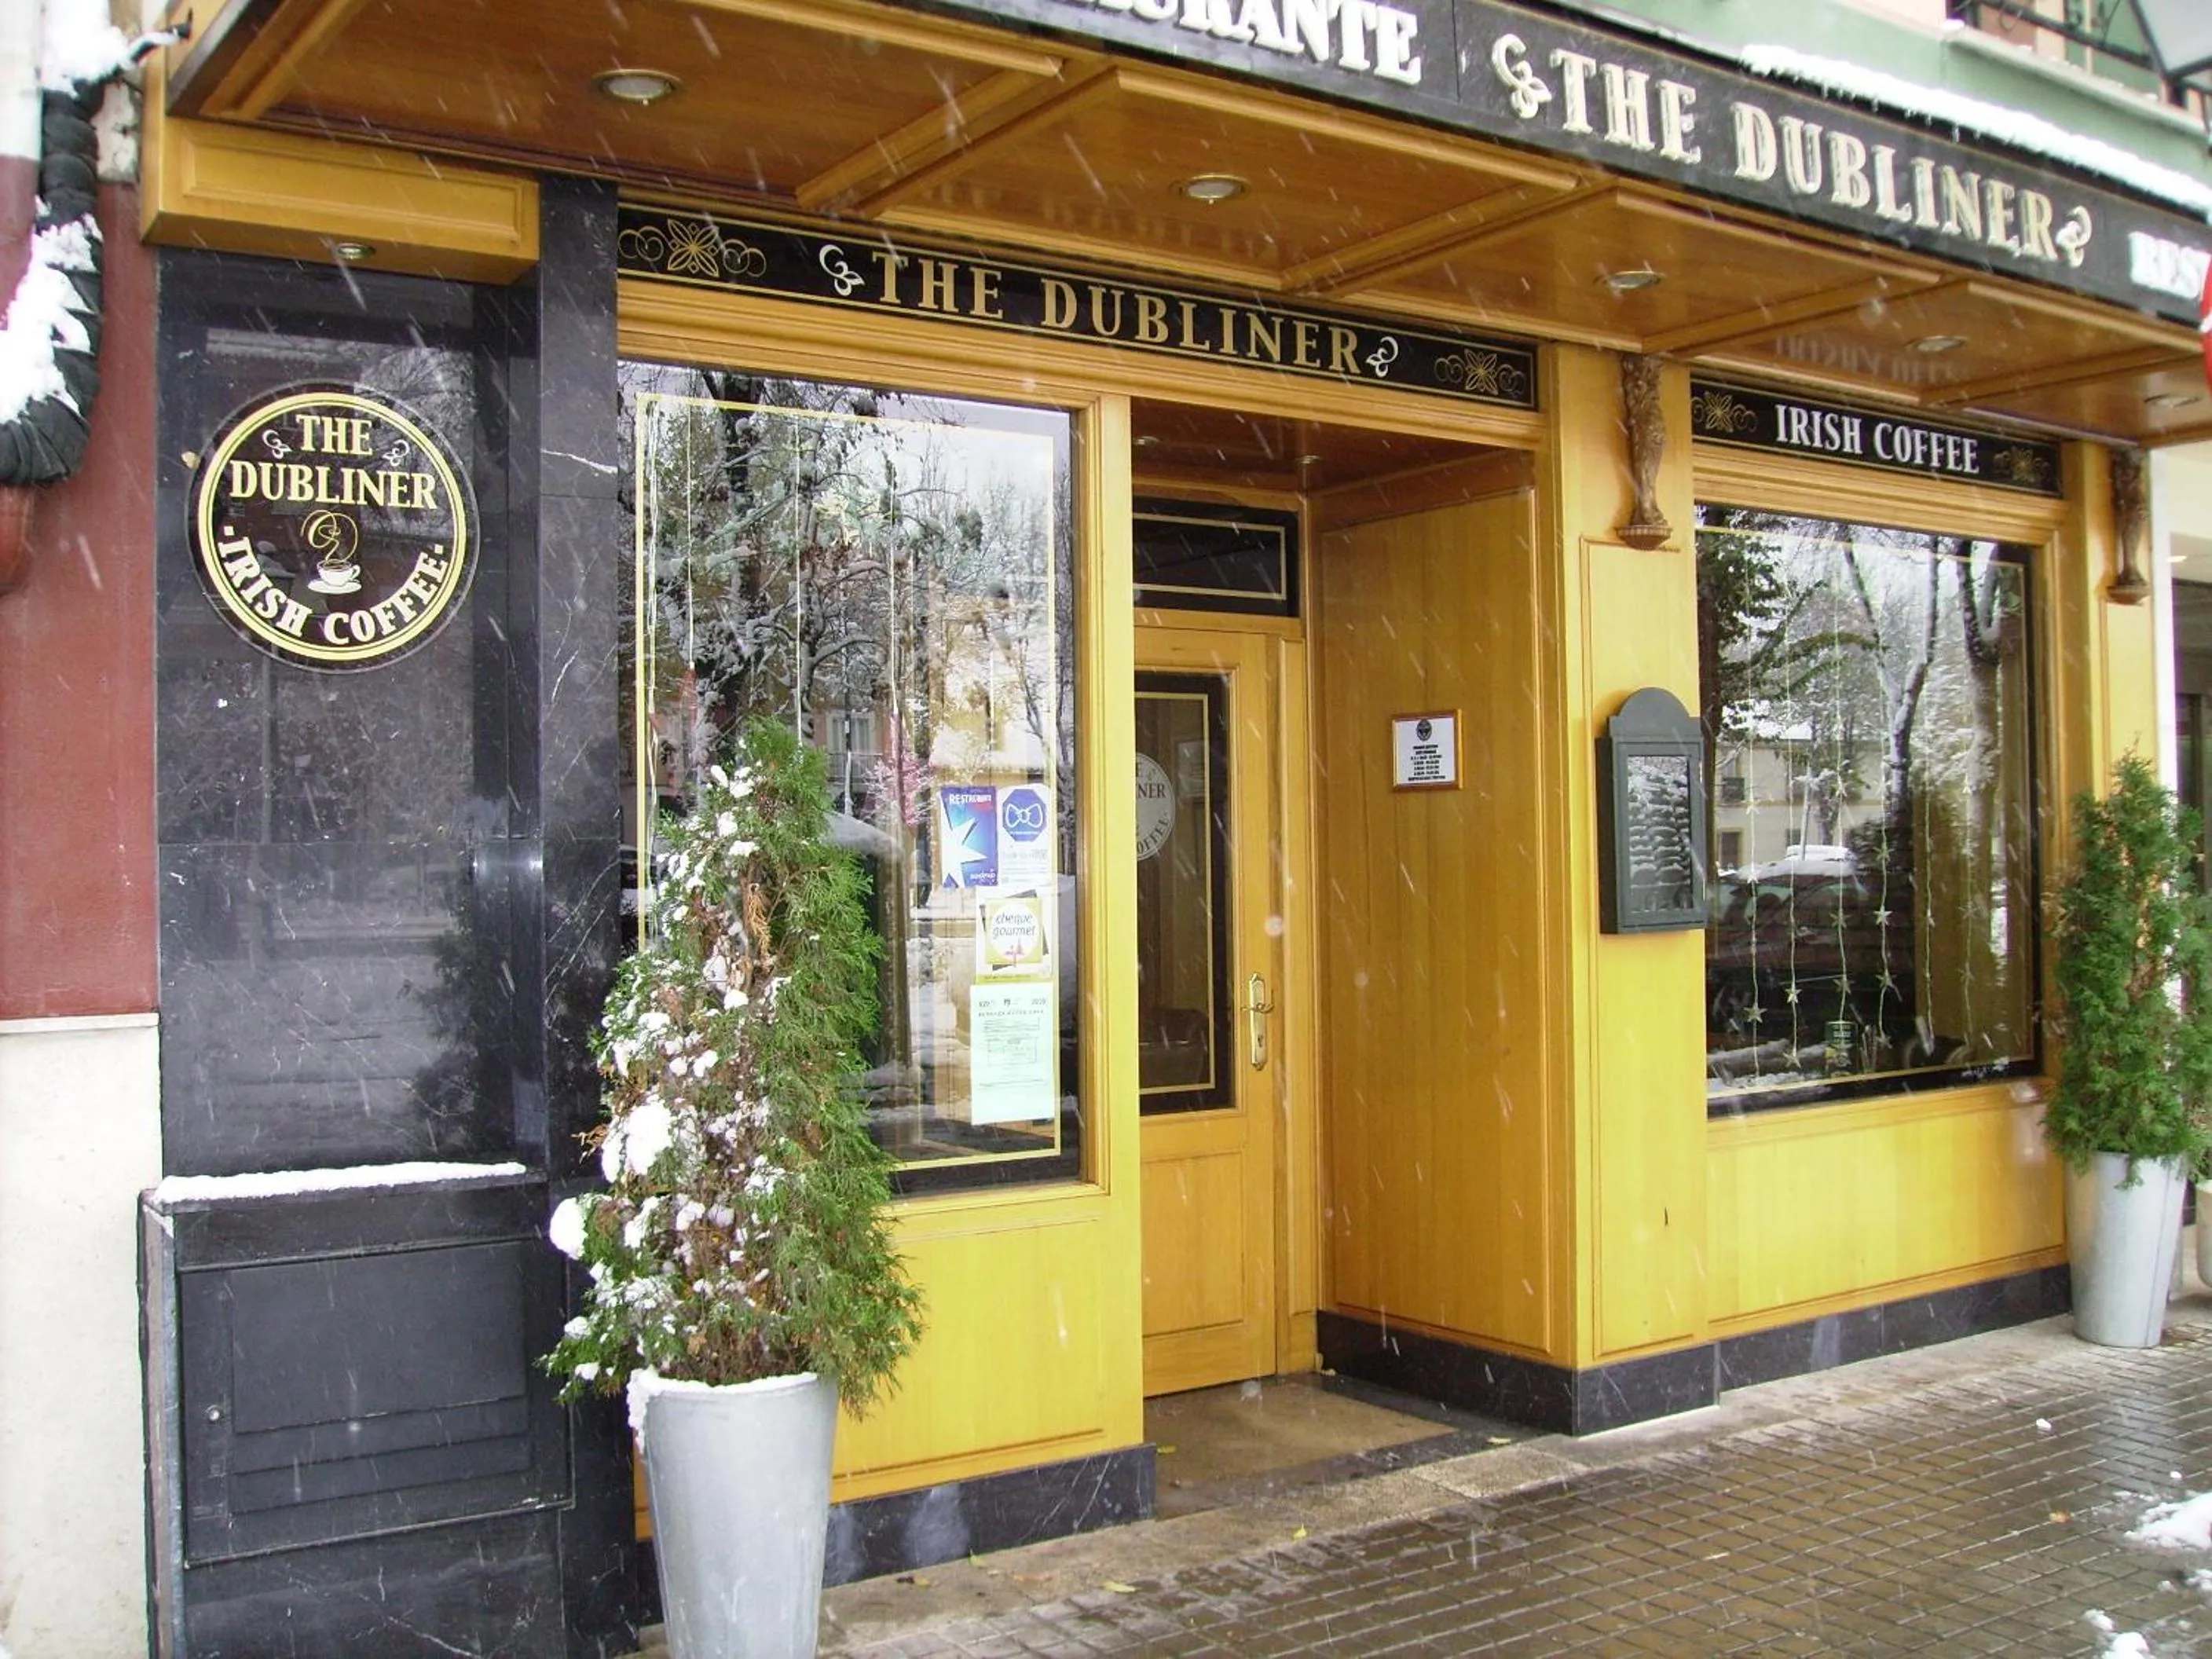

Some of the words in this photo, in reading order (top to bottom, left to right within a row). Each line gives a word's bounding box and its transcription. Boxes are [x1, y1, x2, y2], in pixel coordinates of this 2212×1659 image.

[1084, 0, 1421, 85] RANTE
[1550, 48, 1701, 164] THE
[1730, 101, 2058, 263] DUBLINER
[873, 251, 1003, 319] THE
[1041, 277, 1361, 375] DUBLINER
[295, 413, 373, 456] THE
[1774, 403, 1863, 455] IRISH
[1873, 422, 1980, 474] COFFEE
[229, 460, 438, 510] DUBLINER
[218, 536, 313, 638] IRISH
[324, 550, 448, 644] COFFEE
